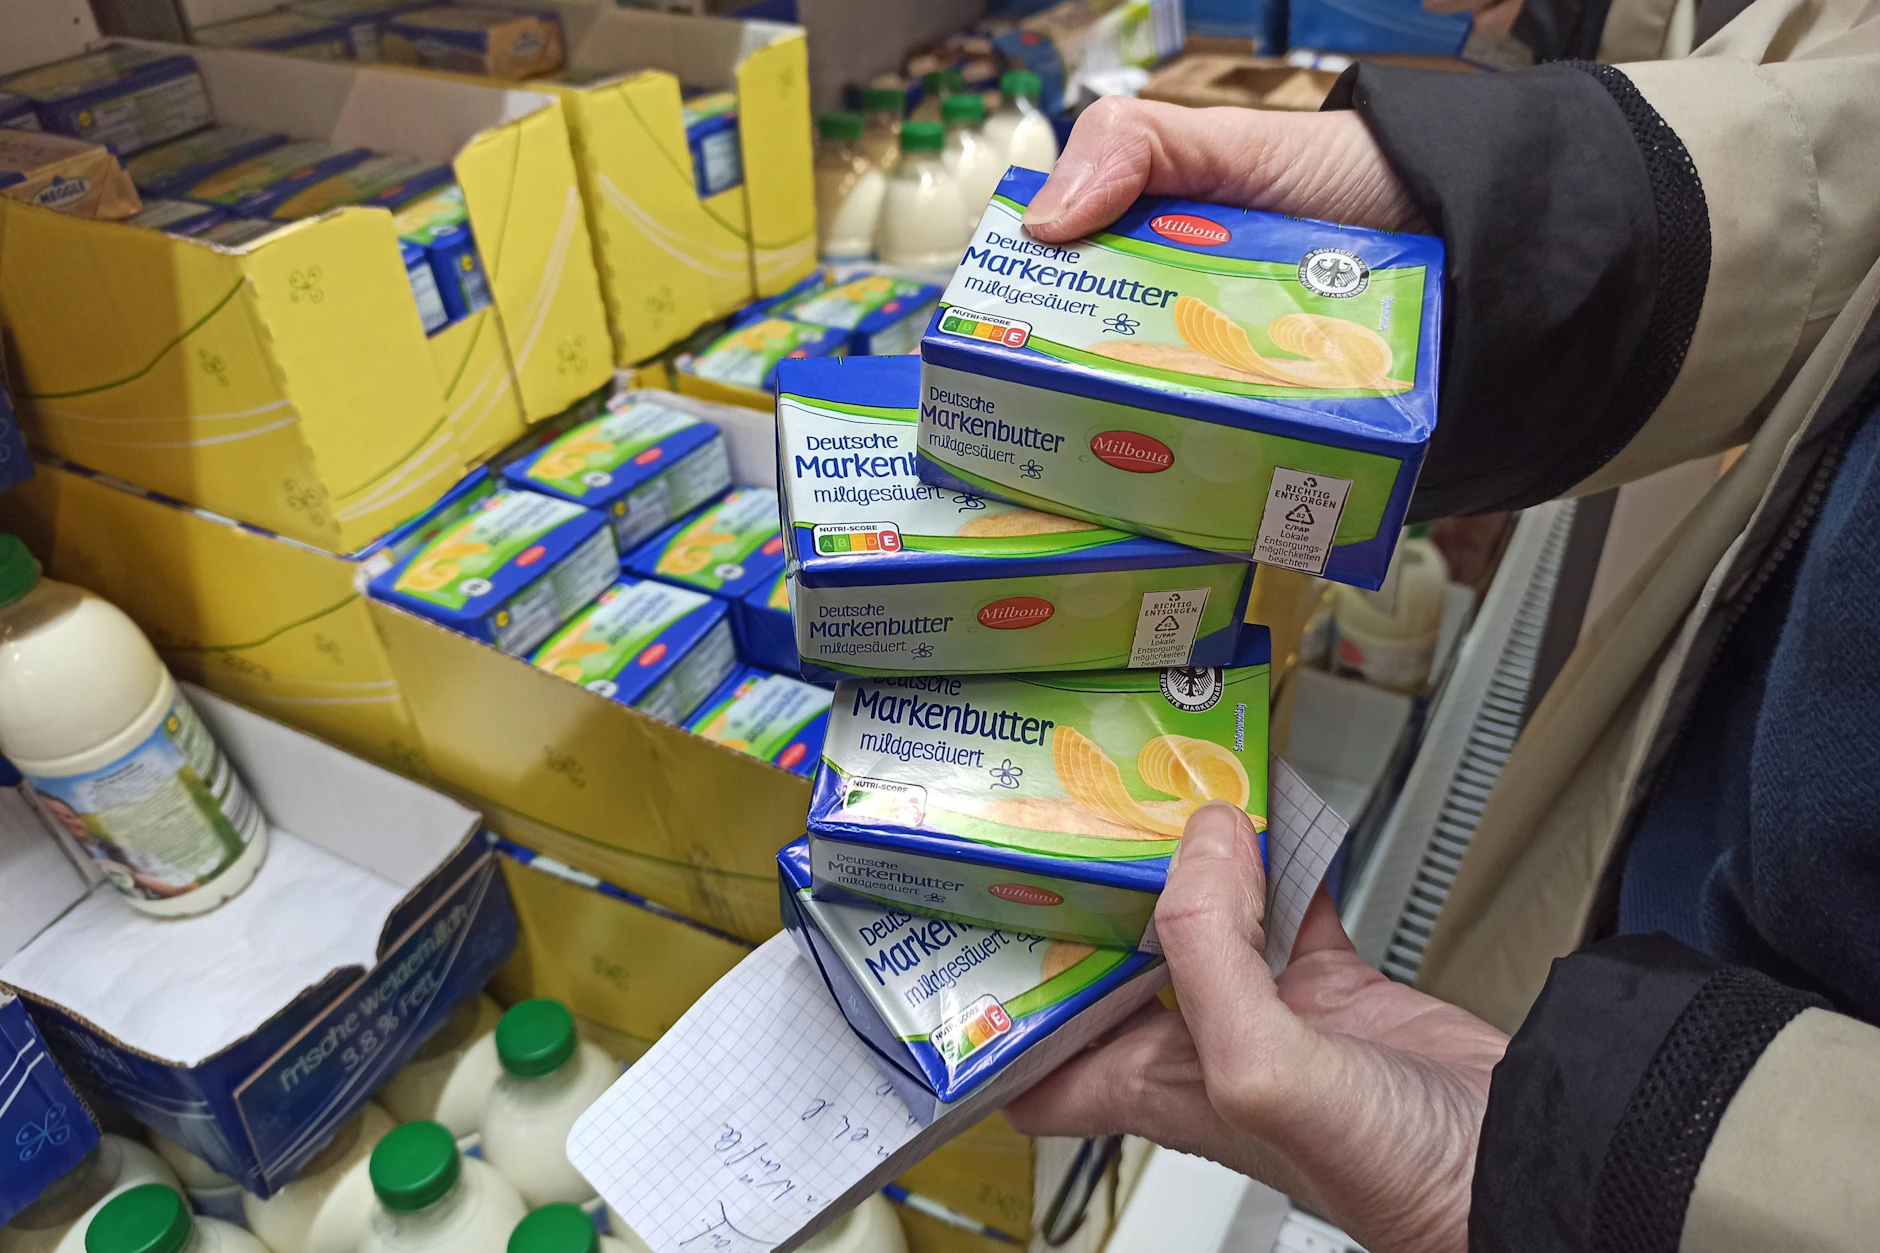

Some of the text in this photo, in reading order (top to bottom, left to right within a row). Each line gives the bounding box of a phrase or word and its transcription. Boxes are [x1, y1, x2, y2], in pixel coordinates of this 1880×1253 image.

[1151, 216, 1228, 241] Milbona
[985, 231, 1081, 264] Deutsche
[960, 246, 1179, 309] Markenbutter
[964, 276, 1100, 317] mildgesäuert
[952, 309, 1012, 326] NUTRI-SCORE
[929, 386, 995, 414] Deutsche
[920, 401, 1065, 453] Markenbutter
[806, 433, 898, 450] Deutsche
[929, 432, 1016, 465] mildgesäuert
[1093, 436, 1169, 465] Milbona
[814, 484, 944, 506] mildgesäuert
[1274, 490, 1336, 509] ENTSORGEN
[1285, 484, 1331, 499] RICHTIG
[1280, 530, 1309, 542] Lokale
[1285, 523, 1310, 533] C/PAP
[1264, 536, 1322, 553] Entsorgungs-
[1259, 545, 1321, 562] möglichkeiten
[1268, 554, 1309, 568] beachten
[819, 603, 885, 618] Deutsche
[980, 606, 1050, 621] Milbona
[1144, 607, 1198, 616] ENTSORGEN
[1153, 601, 1192, 610] RICHTIG
[809, 616, 954, 638] Markenbutter
[819, 640, 907, 656] mildgesäuert
[1137, 645, 1187, 654] Entsorgungs-
[1151, 637, 1176, 646] Lokale
[1133, 651, 1186, 661] möglichkeiten
[1141, 659, 1176, 667] beachten
[873, 676, 961, 696] eutsche
[852, 687, 1054, 746] Markenbutter
[860, 732, 984, 768] mildgesäuert
[853, 780, 908, 793] NUTRI-SCORE
[836, 853, 898, 870] Deutsche
[828, 860, 964, 892] Markenbutter
[838, 875, 920, 896] mildgesäuert
[992, 886, 1058, 904] Milbona
[904, 929, 1010, 1008] mildgesäuert
